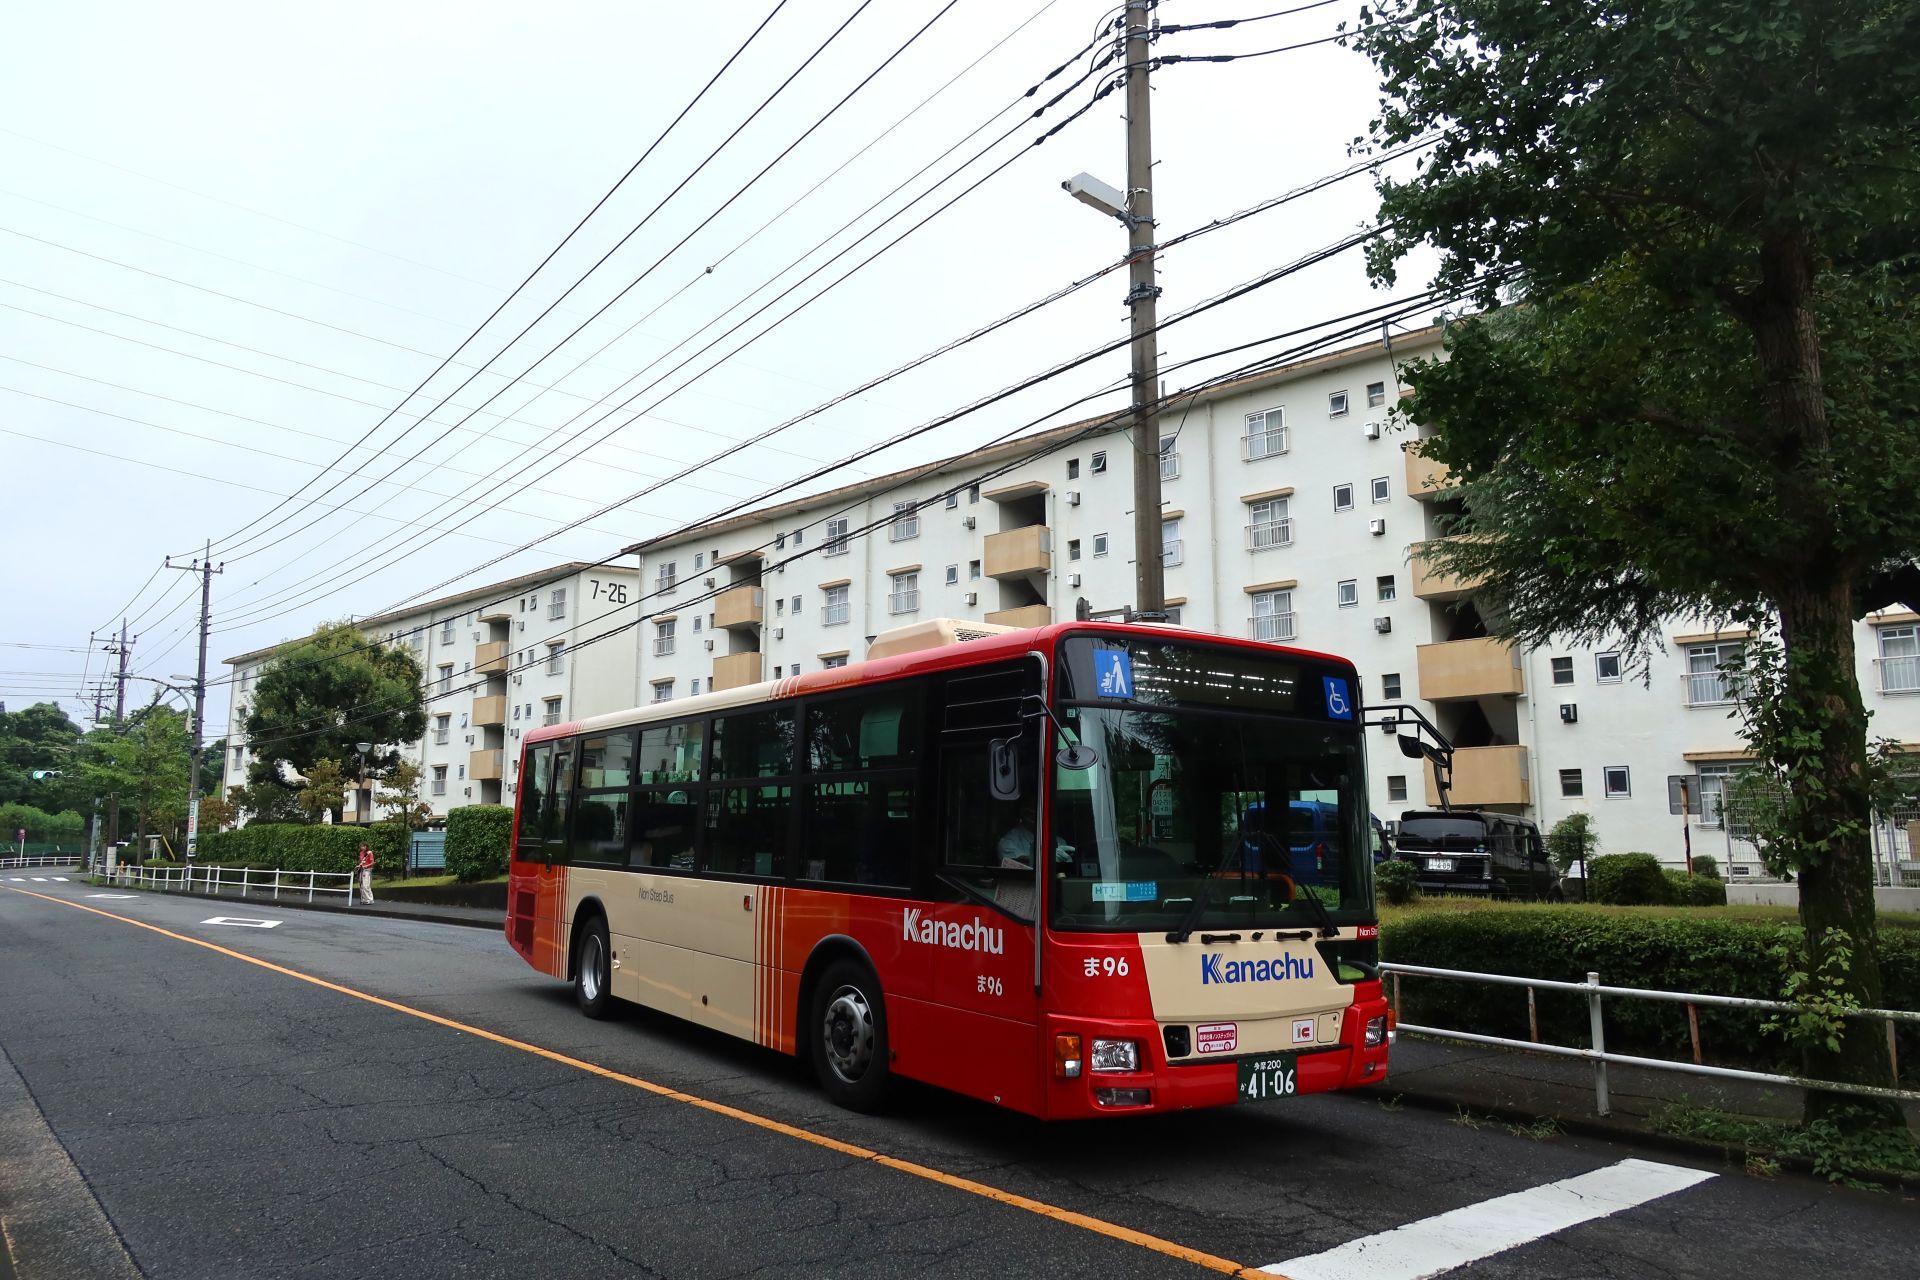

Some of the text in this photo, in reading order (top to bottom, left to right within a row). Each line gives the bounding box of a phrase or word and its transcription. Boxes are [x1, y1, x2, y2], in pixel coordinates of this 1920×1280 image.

[590, 579, 627, 604] 7-26
[638, 887, 675, 904] Non Step Bus
[903, 907, 1003, 954] Kanachu
[1359, 927, 1371, 937] Non
[1083, 957, 1129, 977] ま96
[1201, 951, 1314, 985] Kanachu
[977, 975, 1003, 996] ま96
[1248, 1068, 1294, 1098] 41-06
